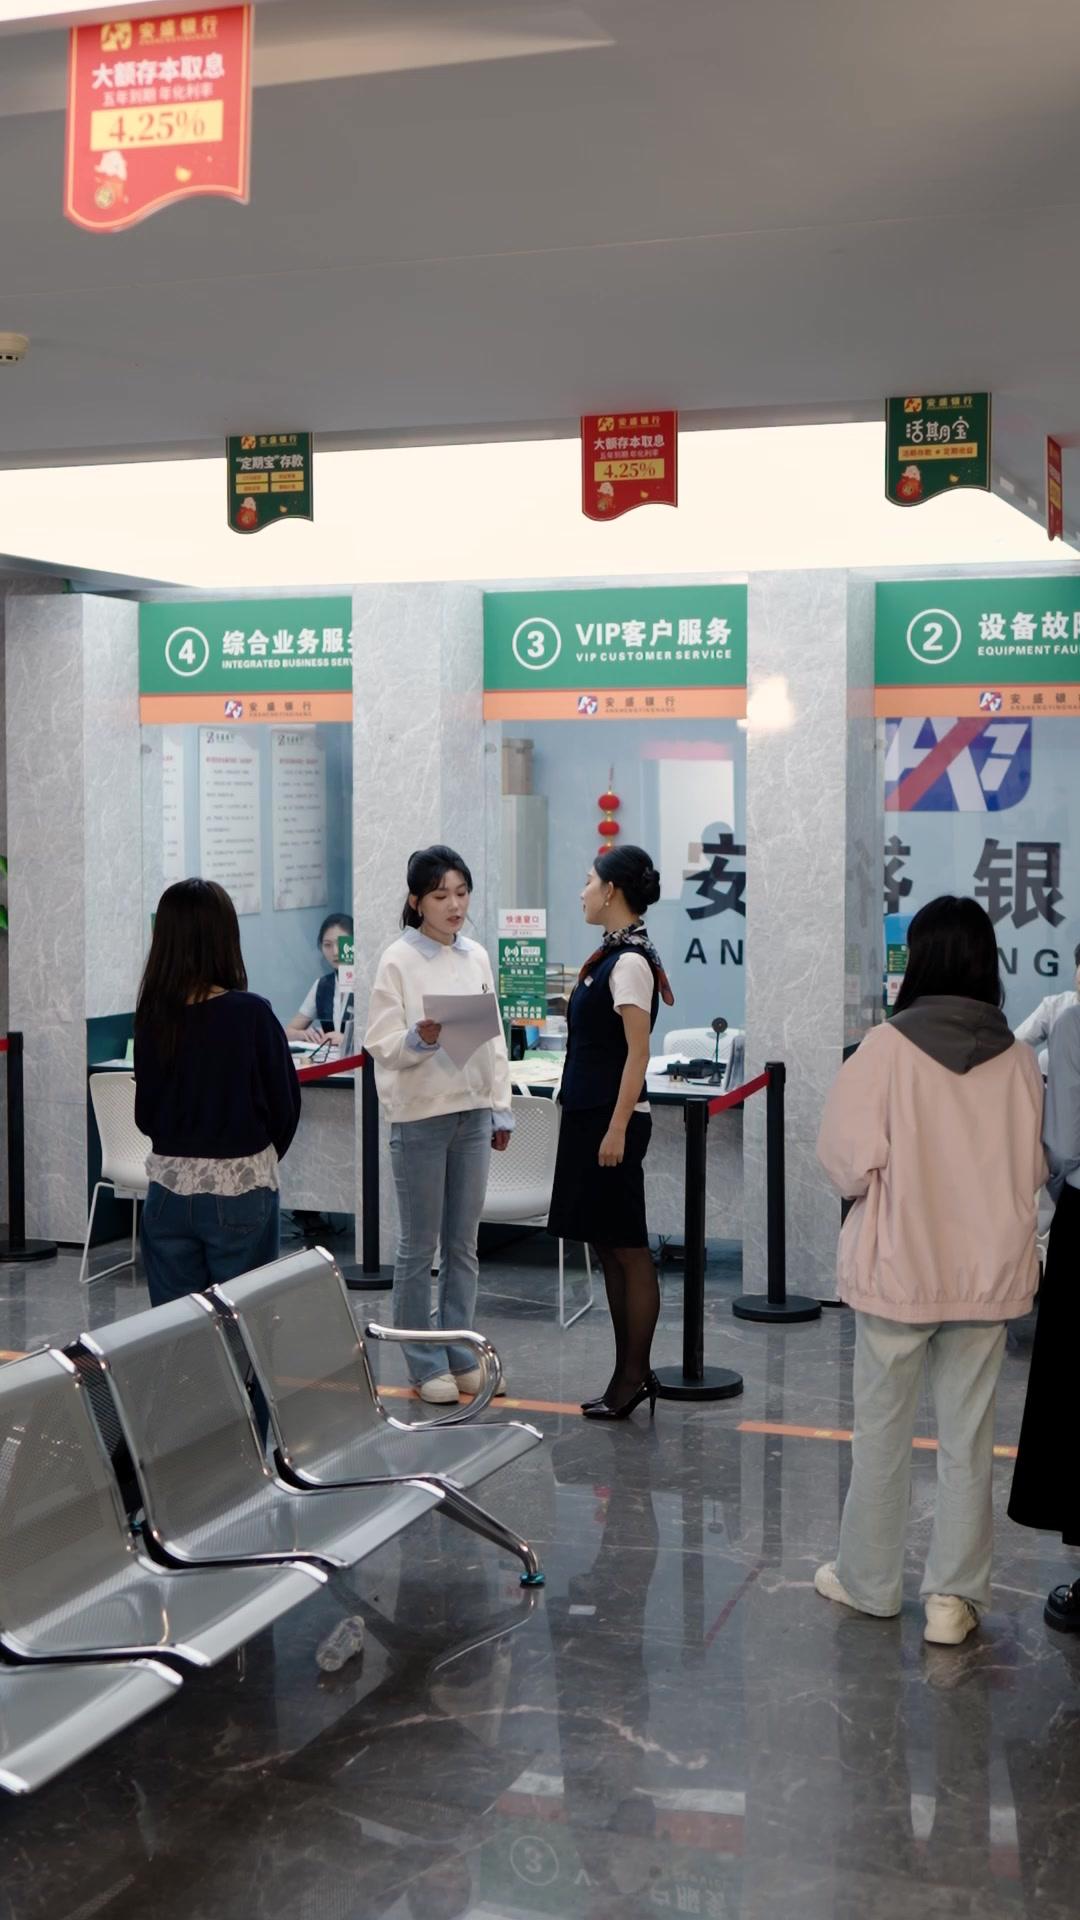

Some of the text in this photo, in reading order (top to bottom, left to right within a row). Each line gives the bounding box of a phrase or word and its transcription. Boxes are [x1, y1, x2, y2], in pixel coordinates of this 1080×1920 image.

[92, 52, 224, 89] 大额存本取息
[108, 110, 206, 142] 4.25%
[593, 434, 665, 450] 大额存本取息
[906, 416, 970, 443] 活期宝
[603, 462, 656, 479] 4.25%
[575, 617, 732, 648] VIP客户服务
[922, 622, 944, 651] 2
[977, 610, 1080, 641] 设备故
[178, 638, 196, 665] 4
[222, 627, 353, 656] 综合业务服
[526, 630, 546, 658] 3
[977, 644, 1080, 656] EQUIPMENT FAU
[222, 658, 281, 669] INTEGRATED
[282, 657, 329, 668] BUSINESS
[576, 649, 732, 662] VIP CUSTOMER SERVICE
[1010, 693, 1080, 704] 安盛银
